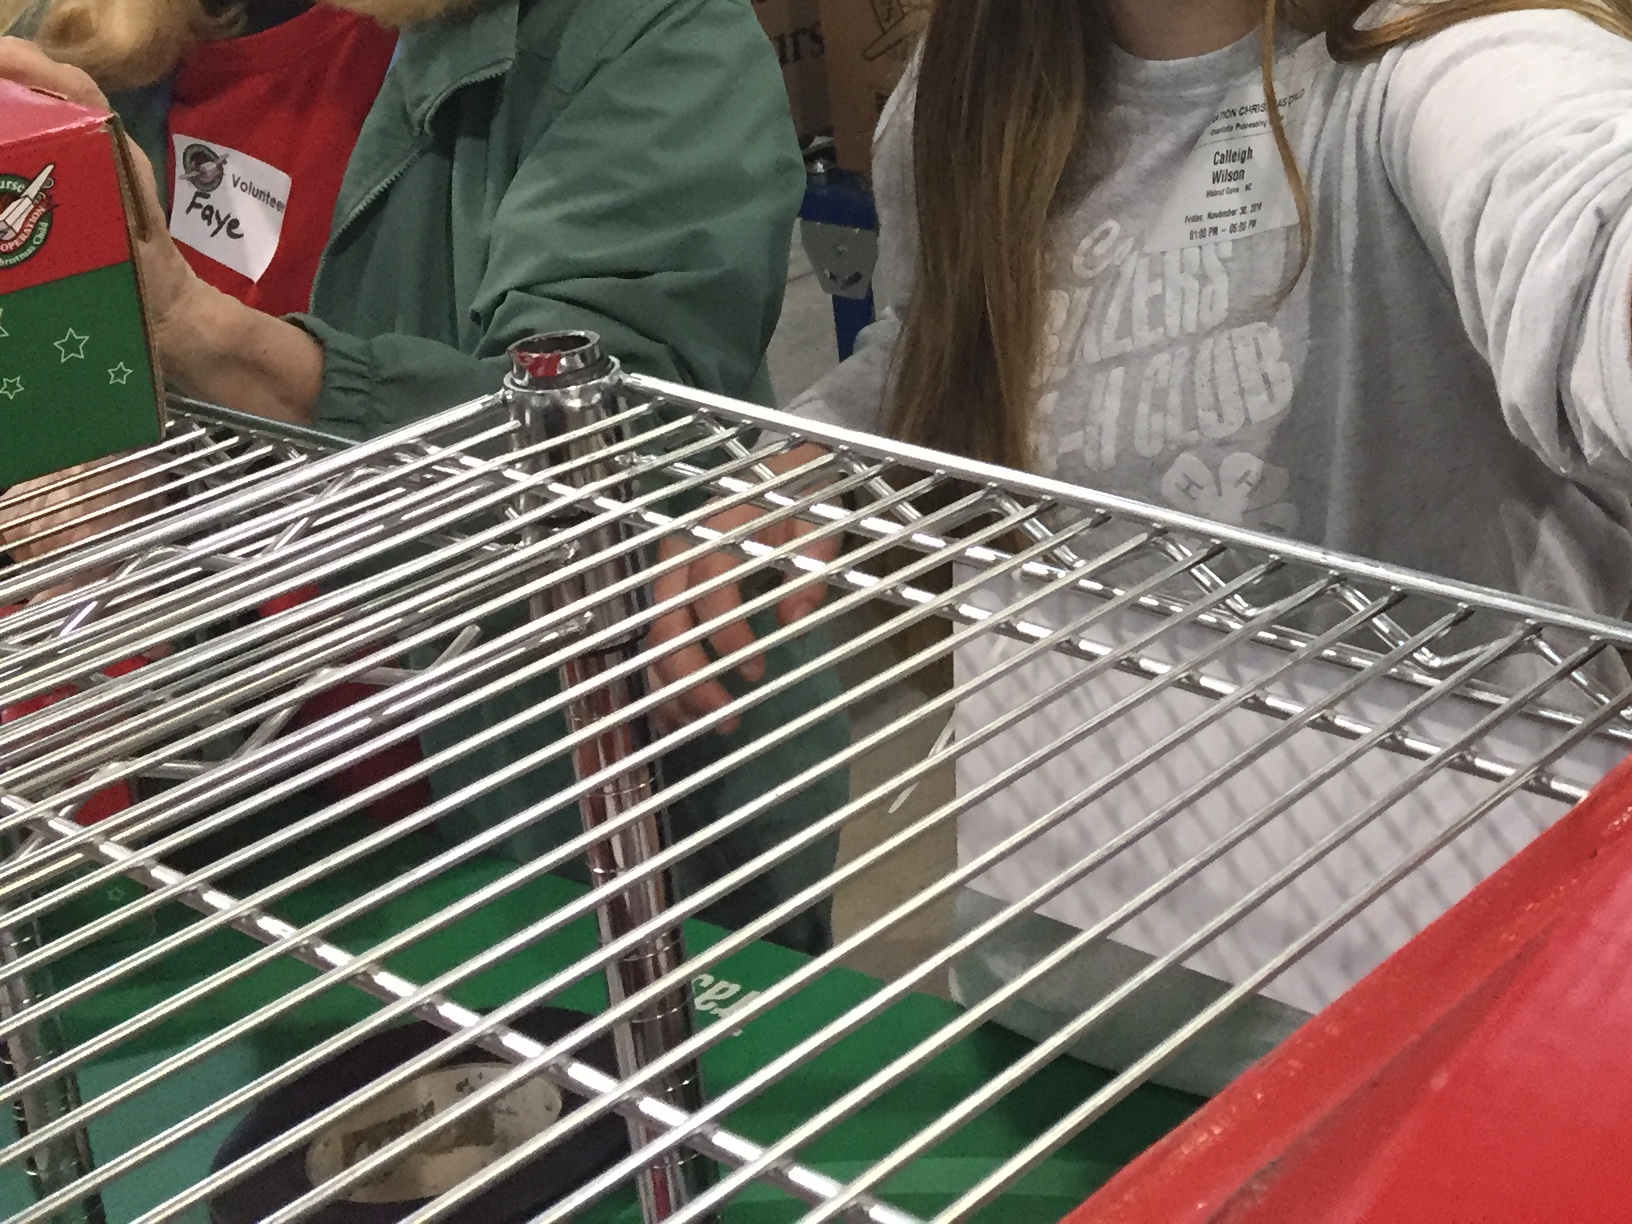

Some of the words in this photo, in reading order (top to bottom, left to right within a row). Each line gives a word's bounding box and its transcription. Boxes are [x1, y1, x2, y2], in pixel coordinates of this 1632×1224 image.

[1213, 146, 1253, 166] Calleigh
[0, 179, 26, 193] urse
[1212, 168, 1245, 185] Wilson
[185, 190, 244, 239] Faye
[0, 205, 46, 252] OPERATION
[33, 221, 49, 245] Child
[1133, 321, 1294, 458] CLUB
